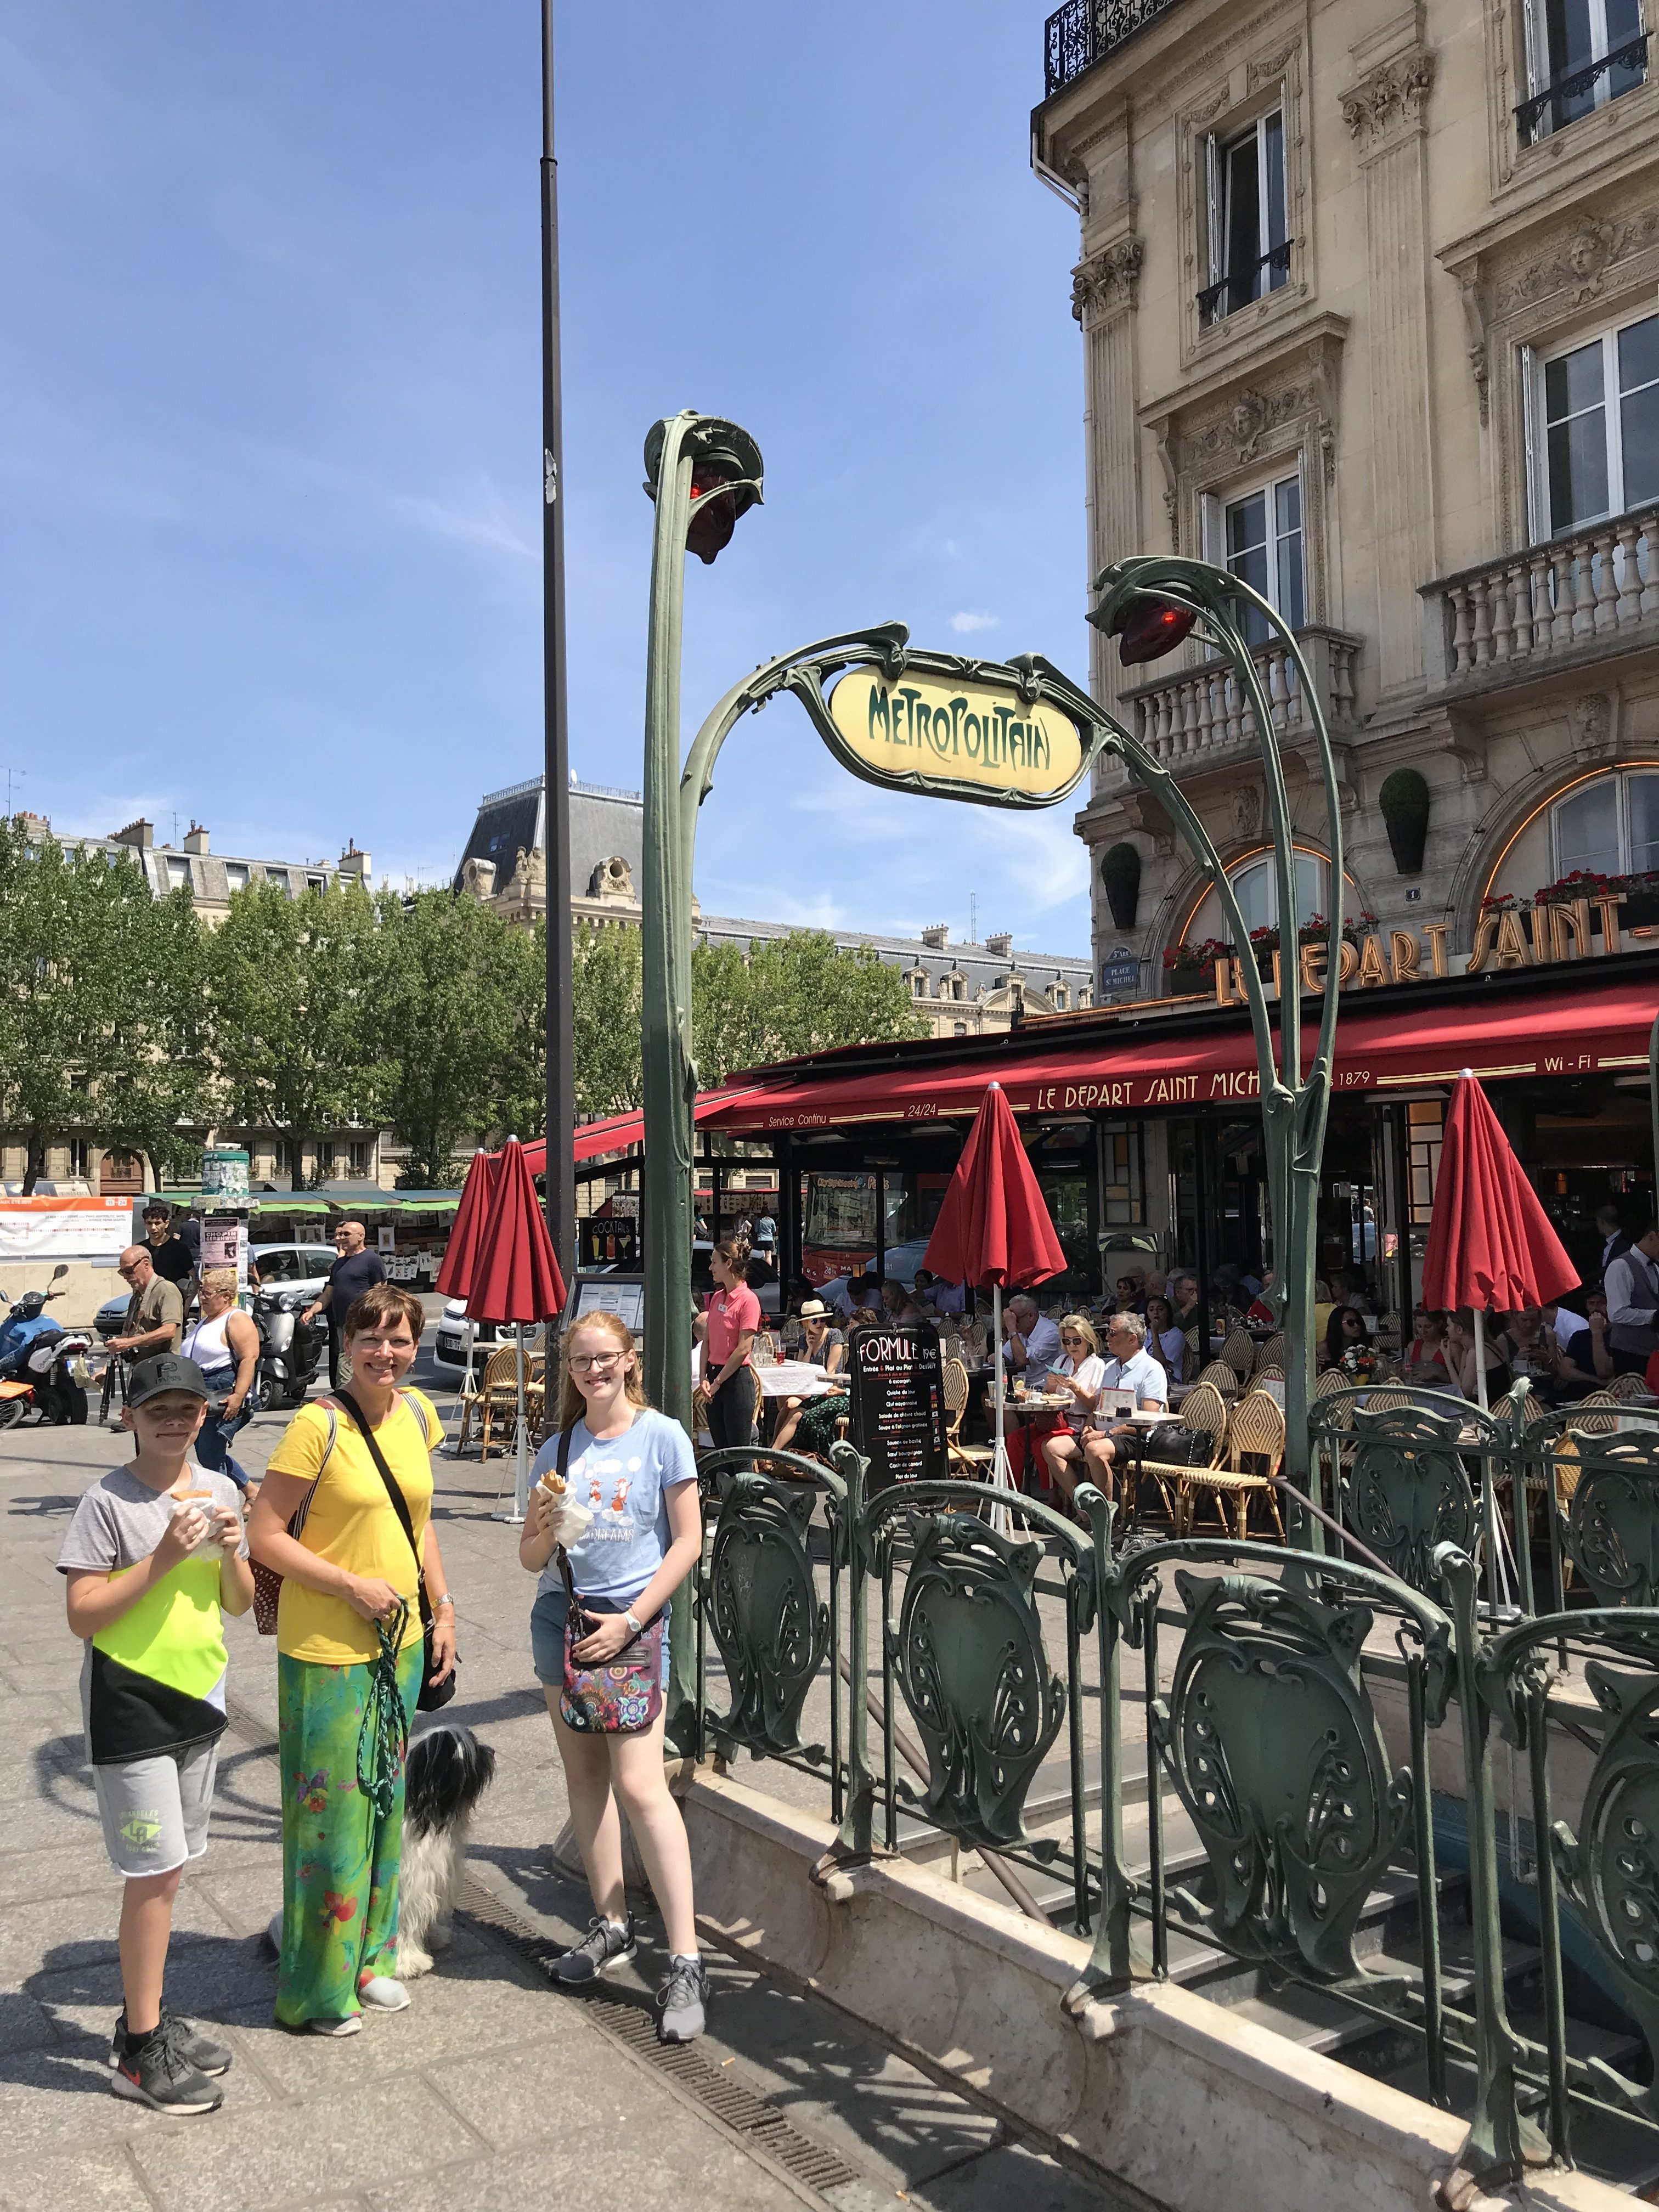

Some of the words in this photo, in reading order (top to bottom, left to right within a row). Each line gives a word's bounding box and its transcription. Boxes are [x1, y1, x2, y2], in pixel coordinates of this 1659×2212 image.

[868, 684, 1050, 772] METROPOLITAIN
[1410, 890, 1415, 899] 1
[1111, 966, 1130, 976] PLACE
[1113, 975, 1135, 985] MICHEL
[1544, 1057, 1563, 1071] Wi
[1578, 1054, 1591, 1069] Fi
[1339, 1070, 1370, 1086] 1879
[1037, 1088, 1056, 1110] LE
[1065, 1081, 1133, 1108] DEPART
[1144, 1075, 1199, 1103] SAINT
[907, 1103, 936, 1118] 24/24
[769, 1116, 794, 1127] Service
[798, 1113, 826, 1125] Continu
[592, 1221, 630, 1233] COCKTAILS
[859, 1337, 919, 1362] FORMULE
[923, 1348, 937, 1360] 19€
[591, 1527, 634, 1543] DREAMS
